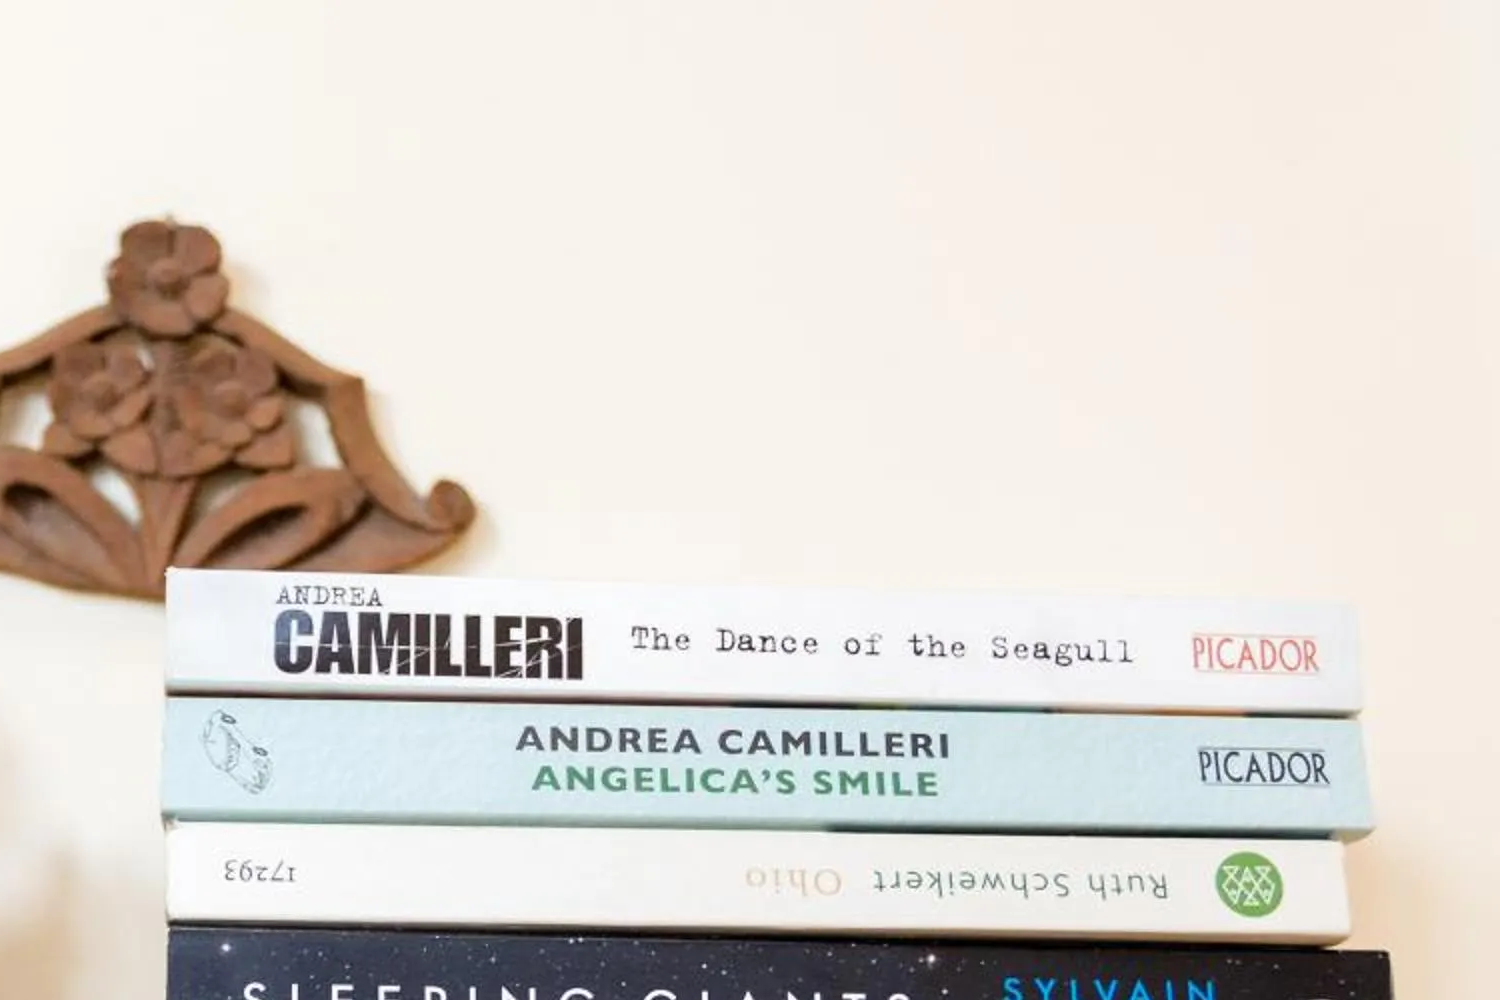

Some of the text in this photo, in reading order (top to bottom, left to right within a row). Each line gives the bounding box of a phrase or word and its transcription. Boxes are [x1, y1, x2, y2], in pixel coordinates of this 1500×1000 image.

[276, 585, 383, 607] ANDREA
[274, 610, 583, 680] CAMILLERI
[631, 625, 1134, 668] The Dance of the Seagull
[1192, 636, 1320, 672] PICADOR
[515, 725, 949, 759] ANDREA CAMILLERI
[813, 769, 939, 797] SMILE
[1199, 750, 1330, 785] PICADOR
[223, 859, 297, 883] 17293
[745, 866, 843, 898] Ohio
[873, 869, 1169, 901] Ruth Schweikert
